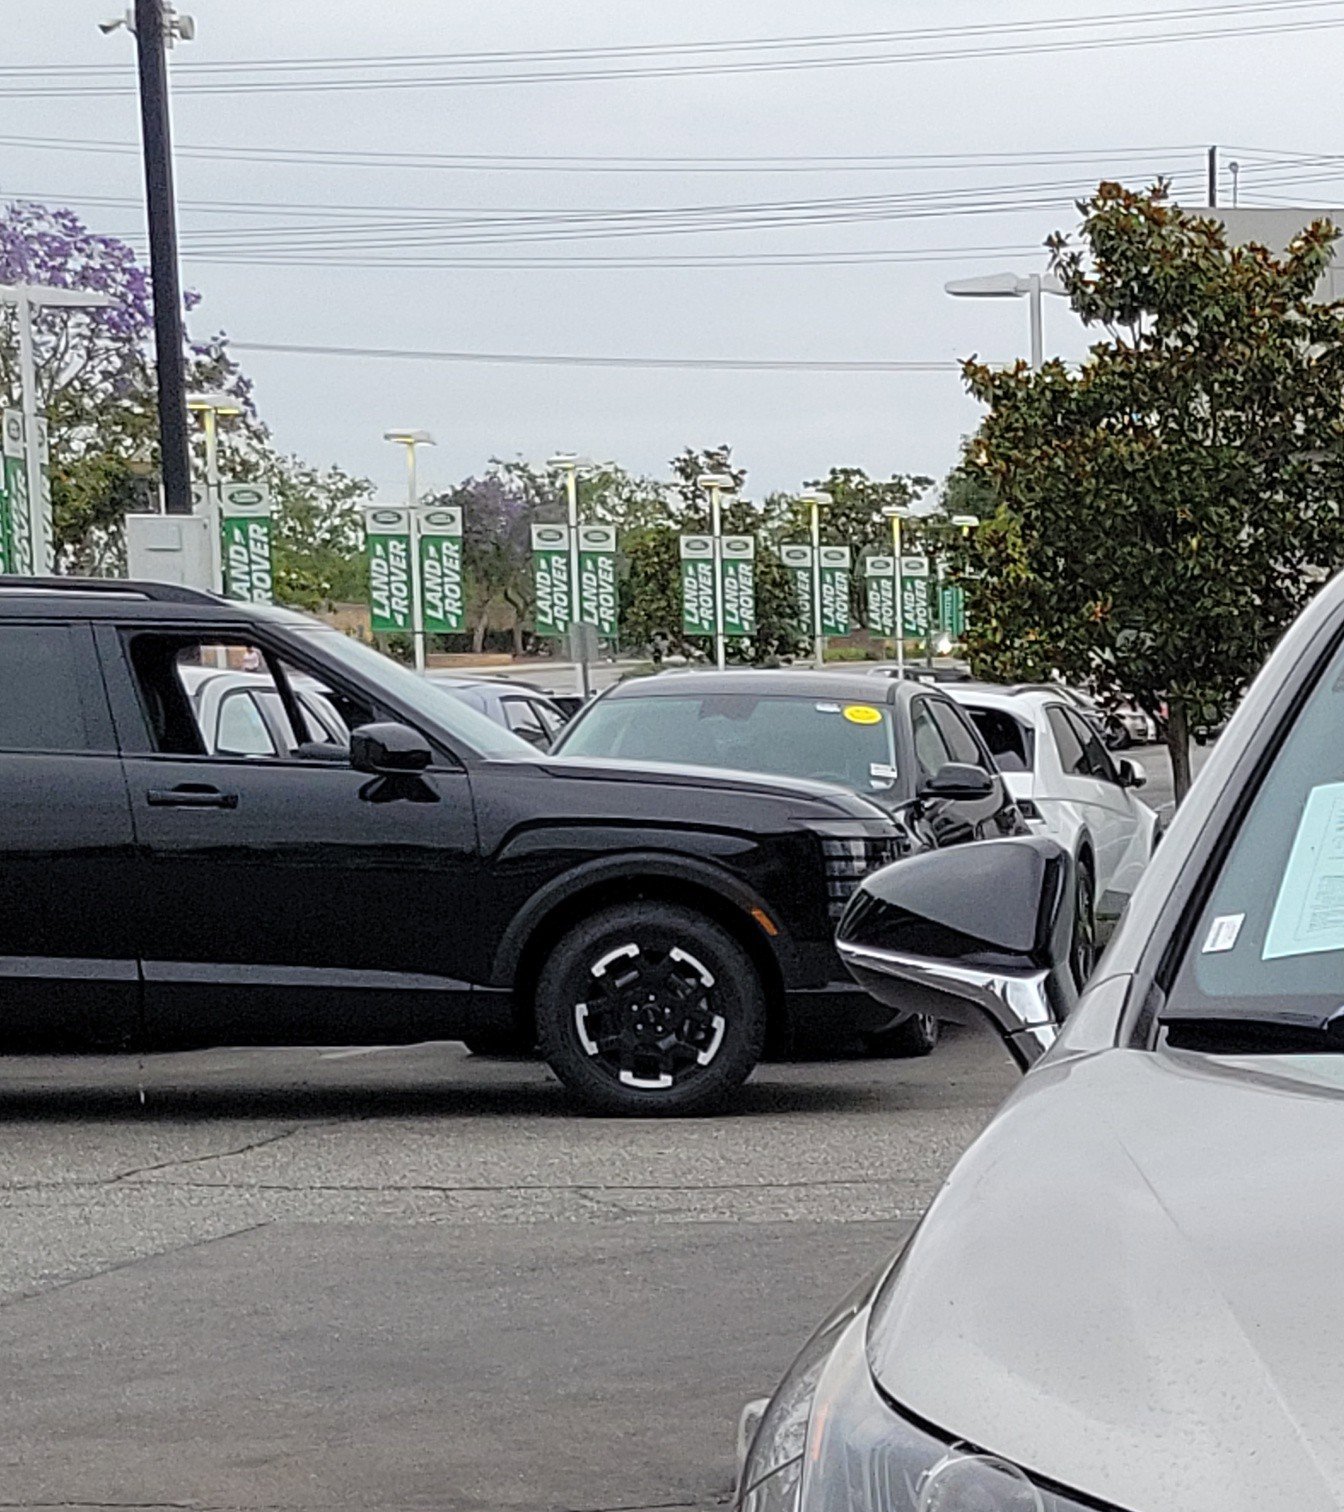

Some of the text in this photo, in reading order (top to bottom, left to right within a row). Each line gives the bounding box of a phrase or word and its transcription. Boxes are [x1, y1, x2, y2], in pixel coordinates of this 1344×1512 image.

[371, 557, 390, 619] LAND
[389, 540, 408, 614] ROVER
[424, 559, 444, 621] LAND
[442, 541, 462, 616] ROVER
[536, 572, 553, 625] LAND
[552, 556, 569, 621] ROVER
[582, 572, 599, 626] LAND
[598, 557, 614, 622] ROVER
[684, 577, 699, 624] LAND
[698, 563, 714, 621] ROVER
[725, 577, 740, 625] LAND
[739, 563, 754, 621] ROVER
[835, 572, 848, 624] ROVER
[881, 579, 894, 627] ROVER
[915, 579, 928, 628] ROVER
[822, 584, 835, 627] LAND
[869, 590, 882, 631] LAND
[904, 590, 917, 631] LAND
